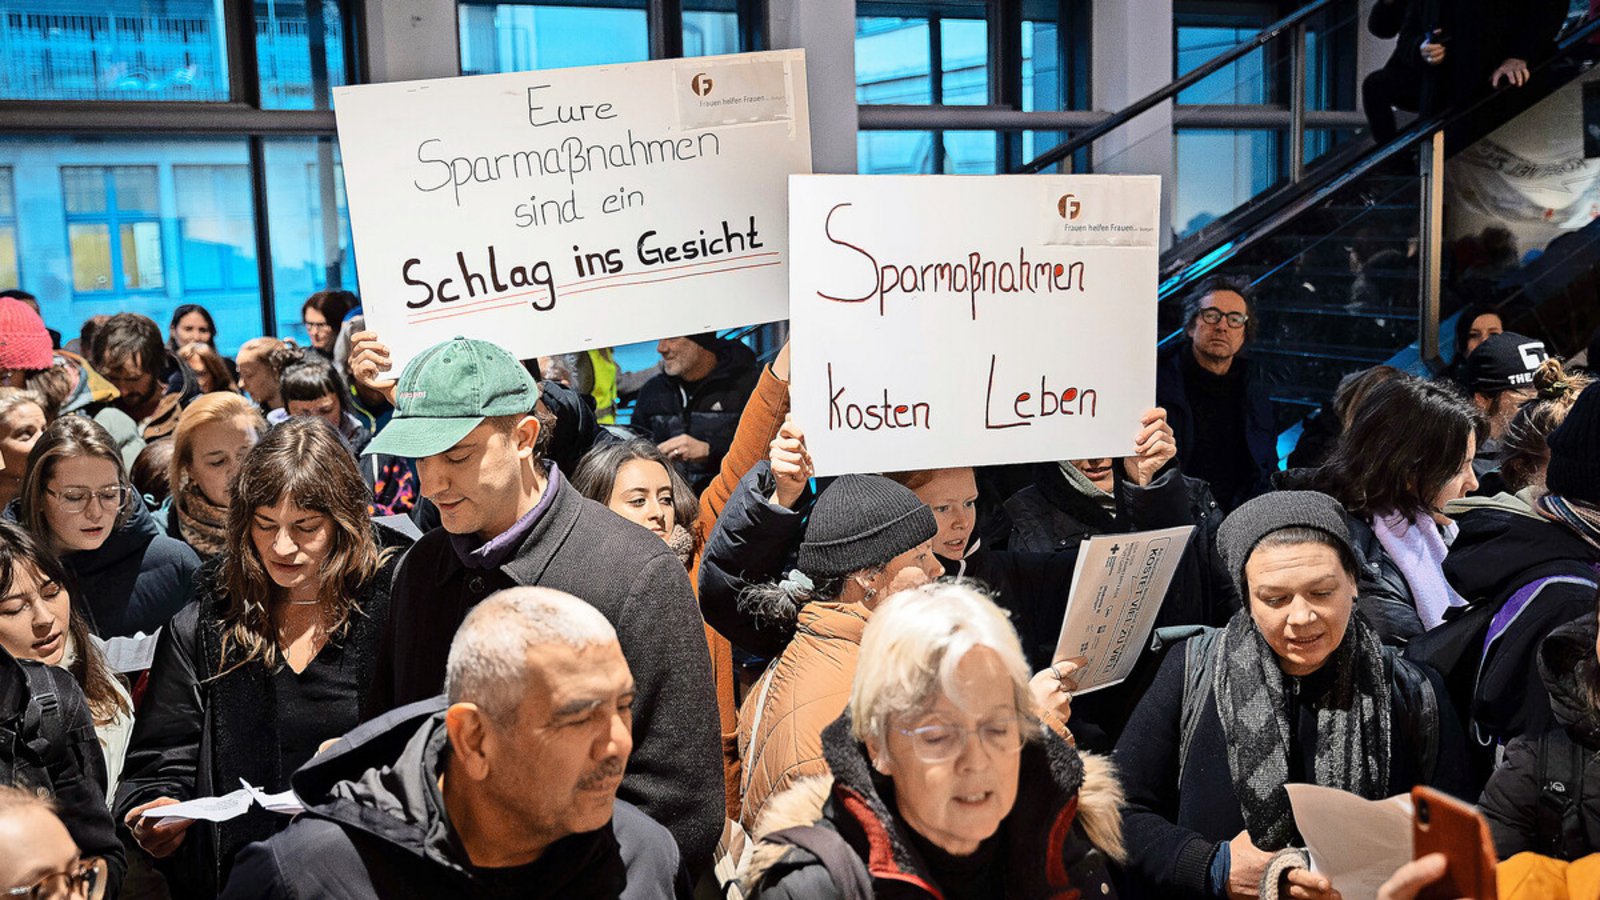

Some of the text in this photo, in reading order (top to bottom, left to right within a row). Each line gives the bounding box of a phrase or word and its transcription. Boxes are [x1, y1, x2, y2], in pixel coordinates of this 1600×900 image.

[527, 85, 618, 128] Eure
[699, 99, 722, 108] Frauen
[743, 95, 765, 104] Frauen
[414, 129, 720, 206] Sparmaßnahmen
[514, 186, 645, 229] sind ein
[1064, 223, 1087, 232] Frauen
[1088, 223, 1109, 231] helfen
[1110, 223, 1134, 232] Frauen
[402, 215, 764, 311] Schlag ins Gesicht
[816, 202, 1085, 321] Sparmaßnahmen
[826, 354, 1097, 431] Kosten Leben
[1135, 547, 1159, 595] KOSTET
[1123, 599, 1140, 626] VIEL
[1117, 629, 1127, 644] ZU
